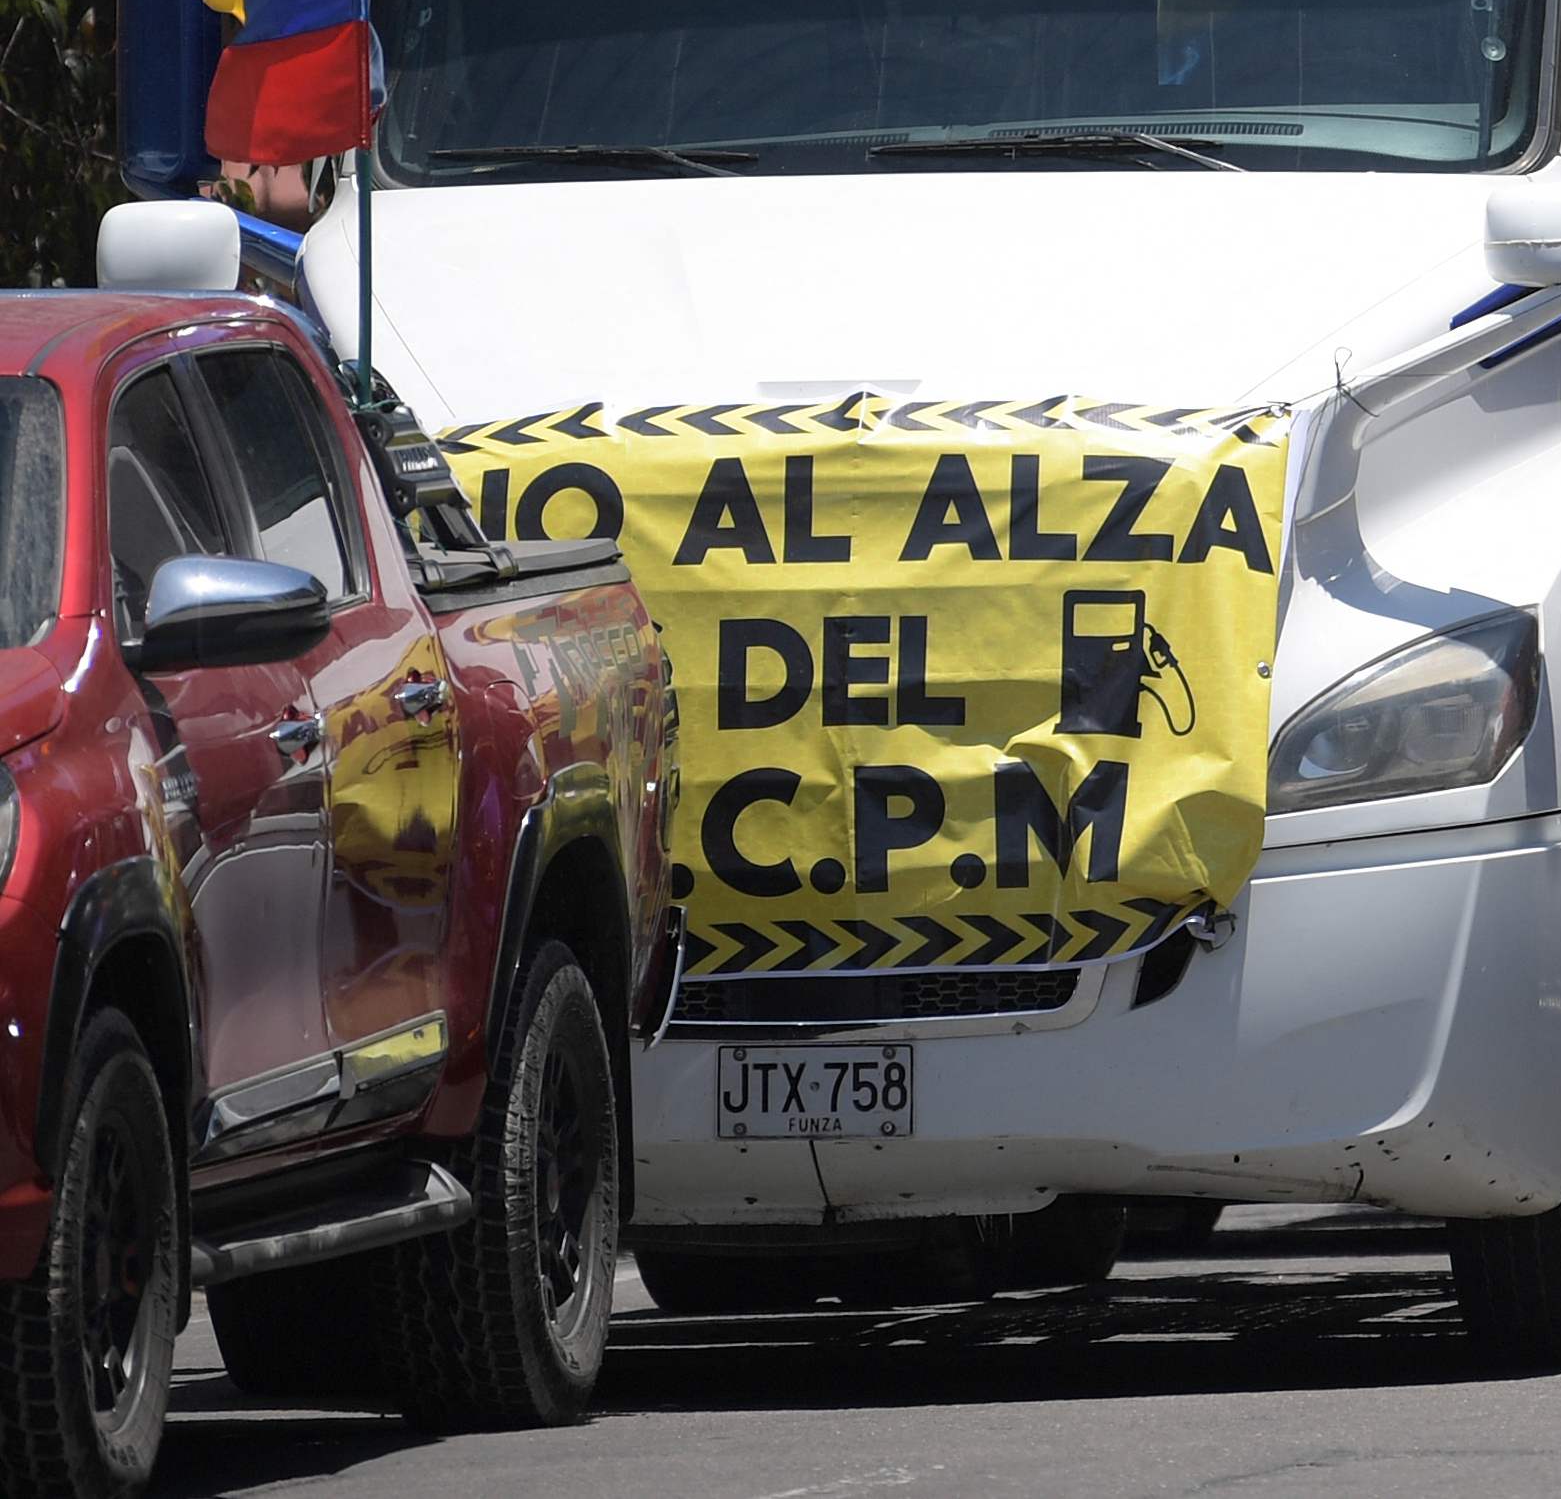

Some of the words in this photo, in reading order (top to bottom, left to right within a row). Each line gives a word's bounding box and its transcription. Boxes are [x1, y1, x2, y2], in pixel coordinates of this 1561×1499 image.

[673, 455, 852, 567] AL
[899, 453, 1275, 575] ALZA
[717, 615, 966, 731] DEL
[723, 1062, 807, 1114] JTX
[824, 1061, 908, 1113] 758
[788, 1118, 843, 1132] FUNZA
